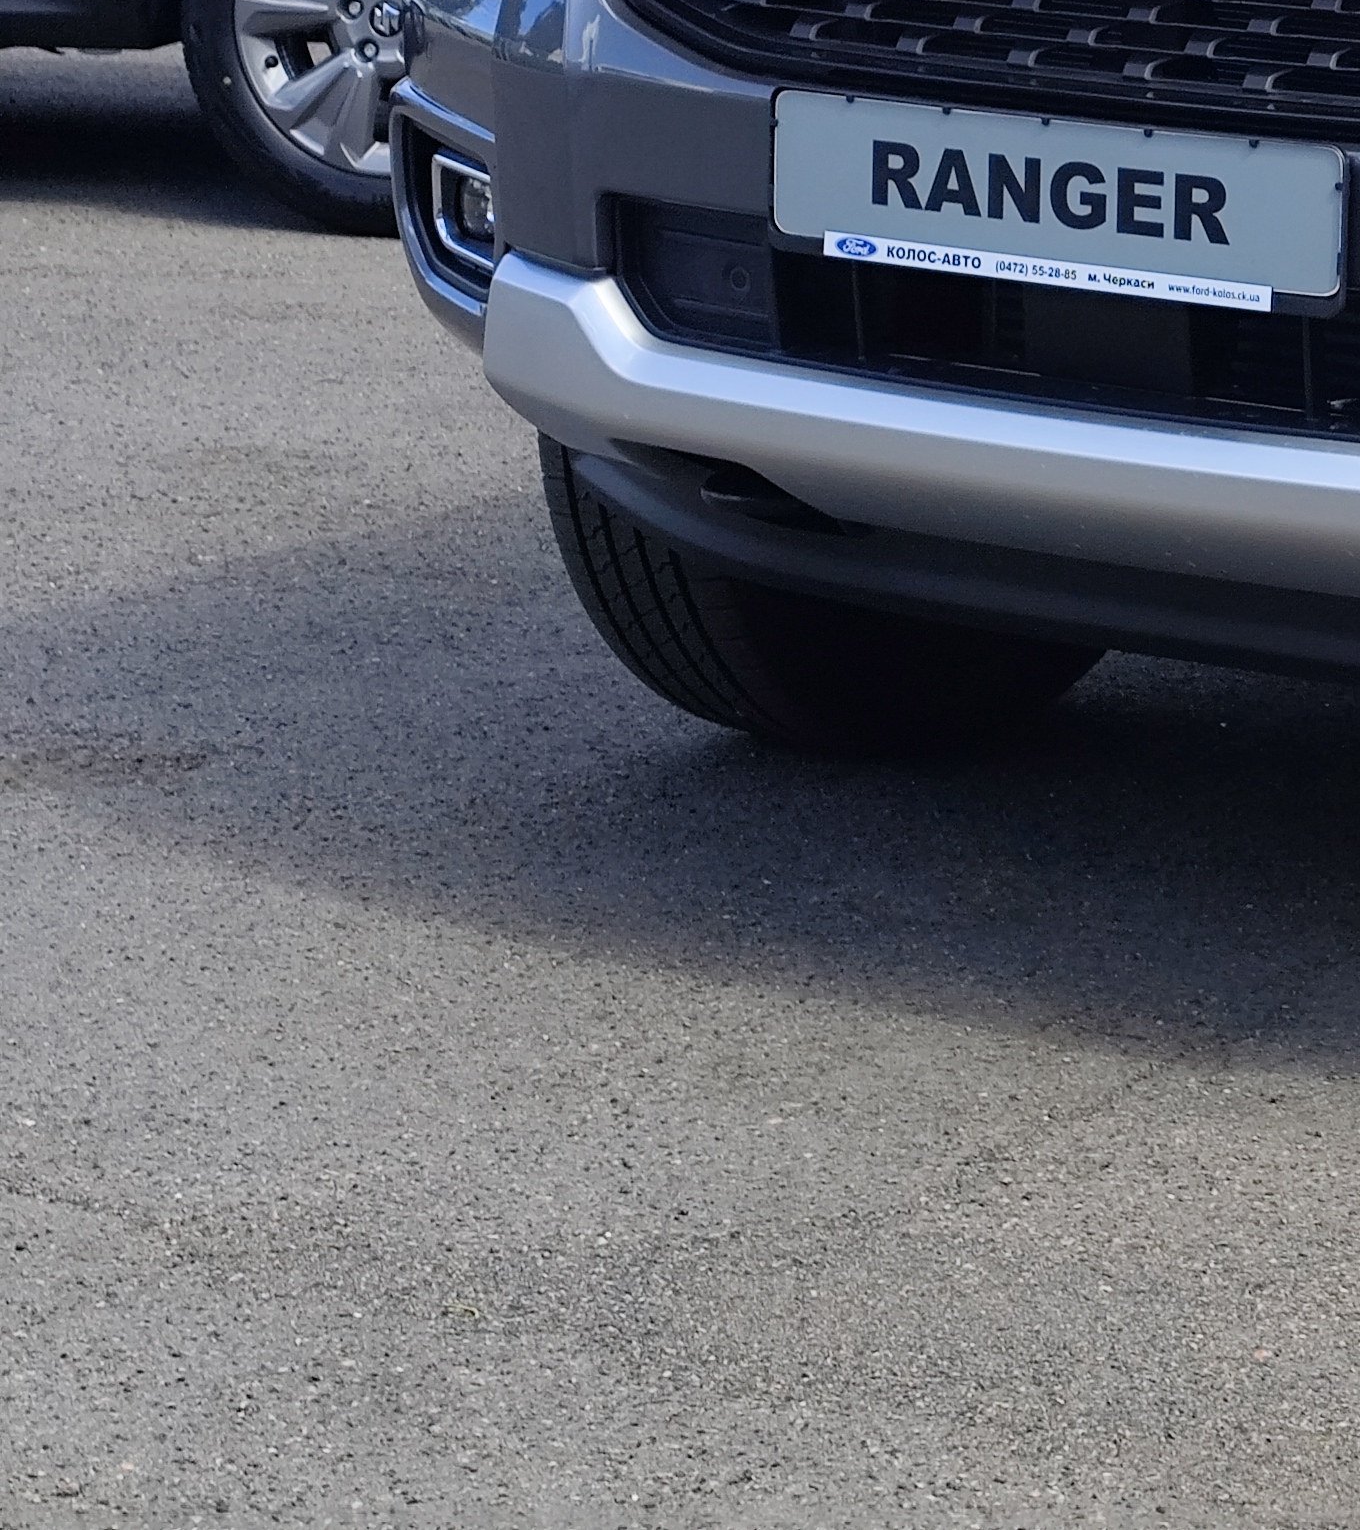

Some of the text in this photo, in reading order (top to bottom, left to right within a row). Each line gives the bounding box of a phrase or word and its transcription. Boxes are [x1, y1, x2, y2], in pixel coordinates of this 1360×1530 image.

[872, 139, 1230, 246] RANGER
[842, 237, 871, 256] Ford
[886, 245, 982, 270] КОЛОС-АВТО
[995, 260, 1029, 277] (0472)
[1032, 264, 1078, 281] 55-28-85
[1103, 272, 1155, 289] Черкаси
[1168, 283, 1261, 303] www.ford-kolos.ck.ua
